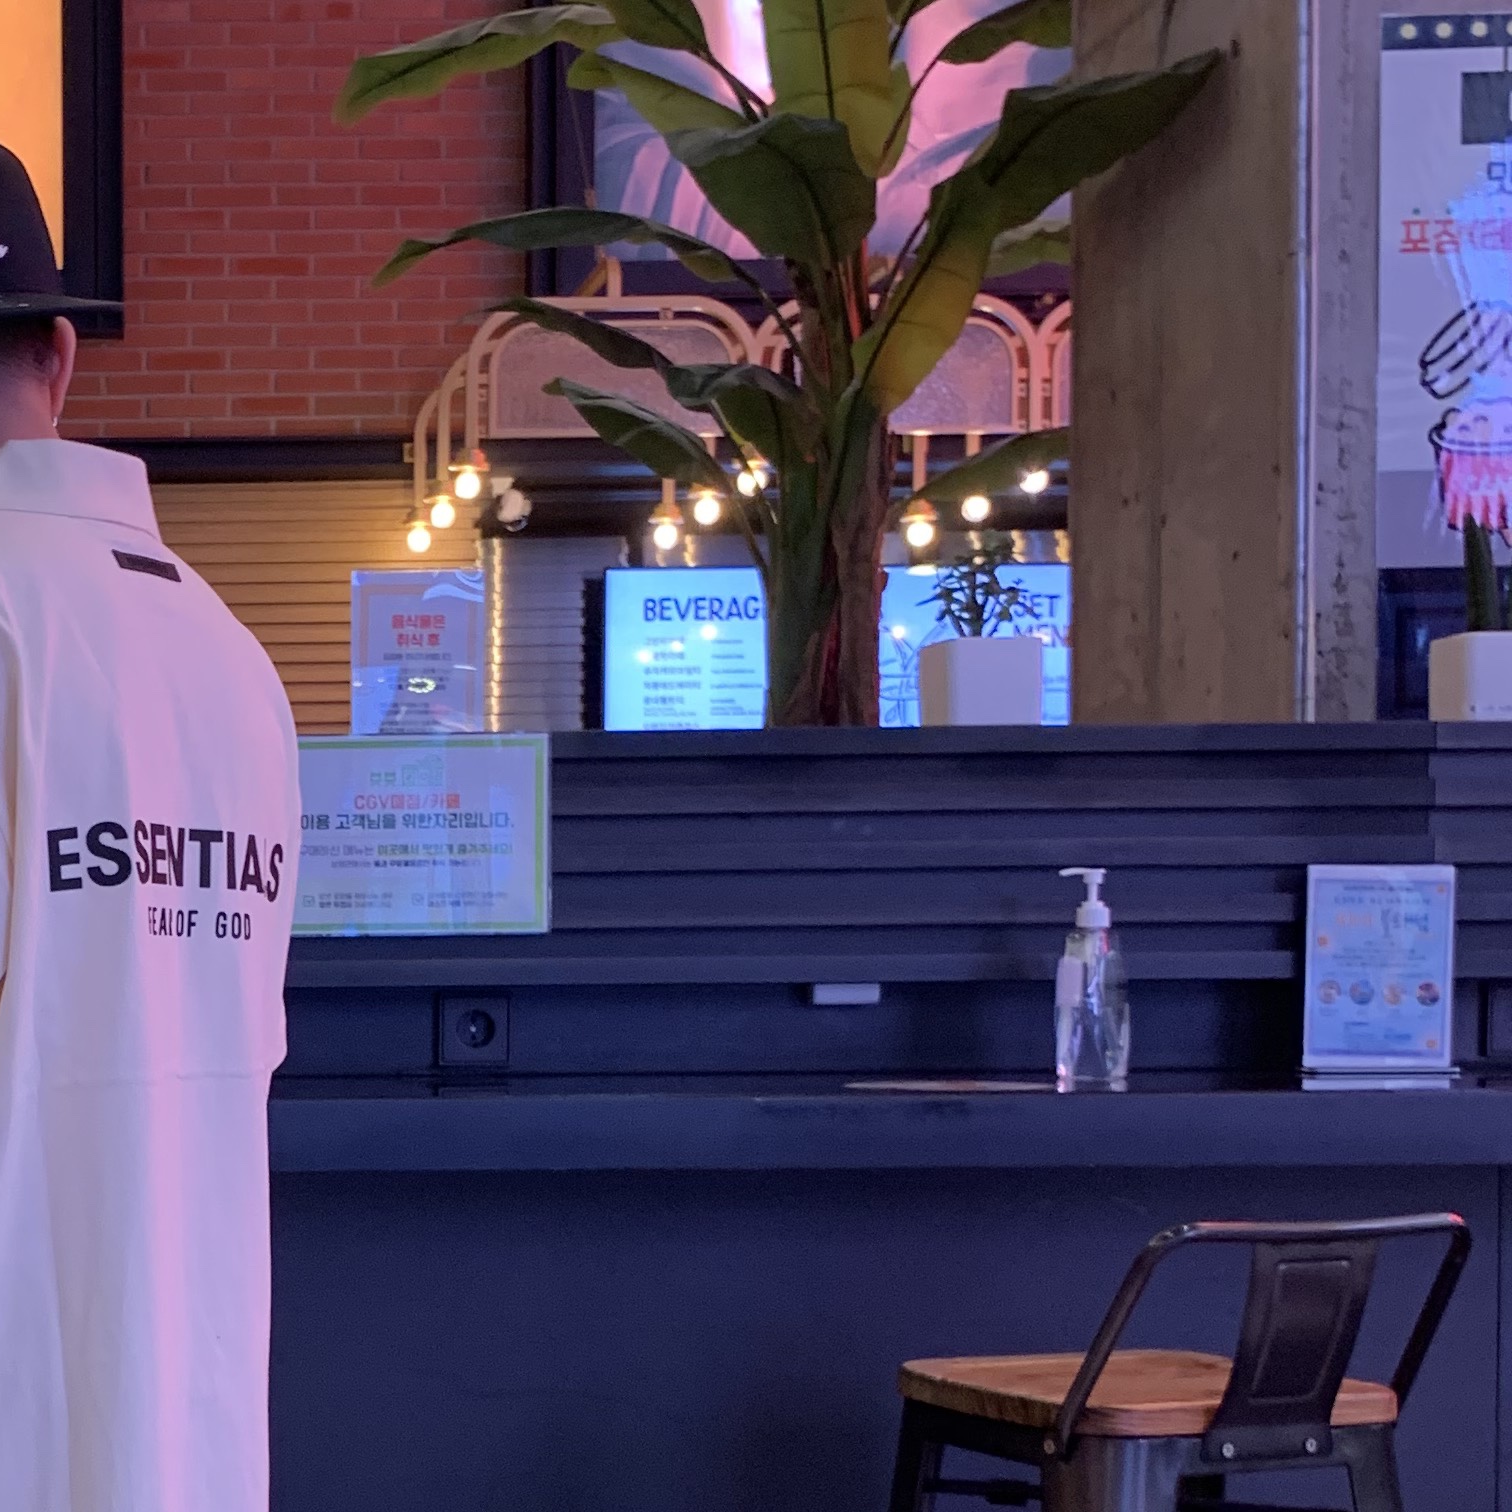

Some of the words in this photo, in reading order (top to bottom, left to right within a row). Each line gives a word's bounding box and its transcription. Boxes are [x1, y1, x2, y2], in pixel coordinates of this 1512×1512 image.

[643, 596, 760, 622] BEVERAG
[300, 814, 330, 830] 이용
[335, 813, 397, 830] 고객님을
[46, 820, 284, 902] ESSENTIAS
[215, 911, 251, 940] GOD
